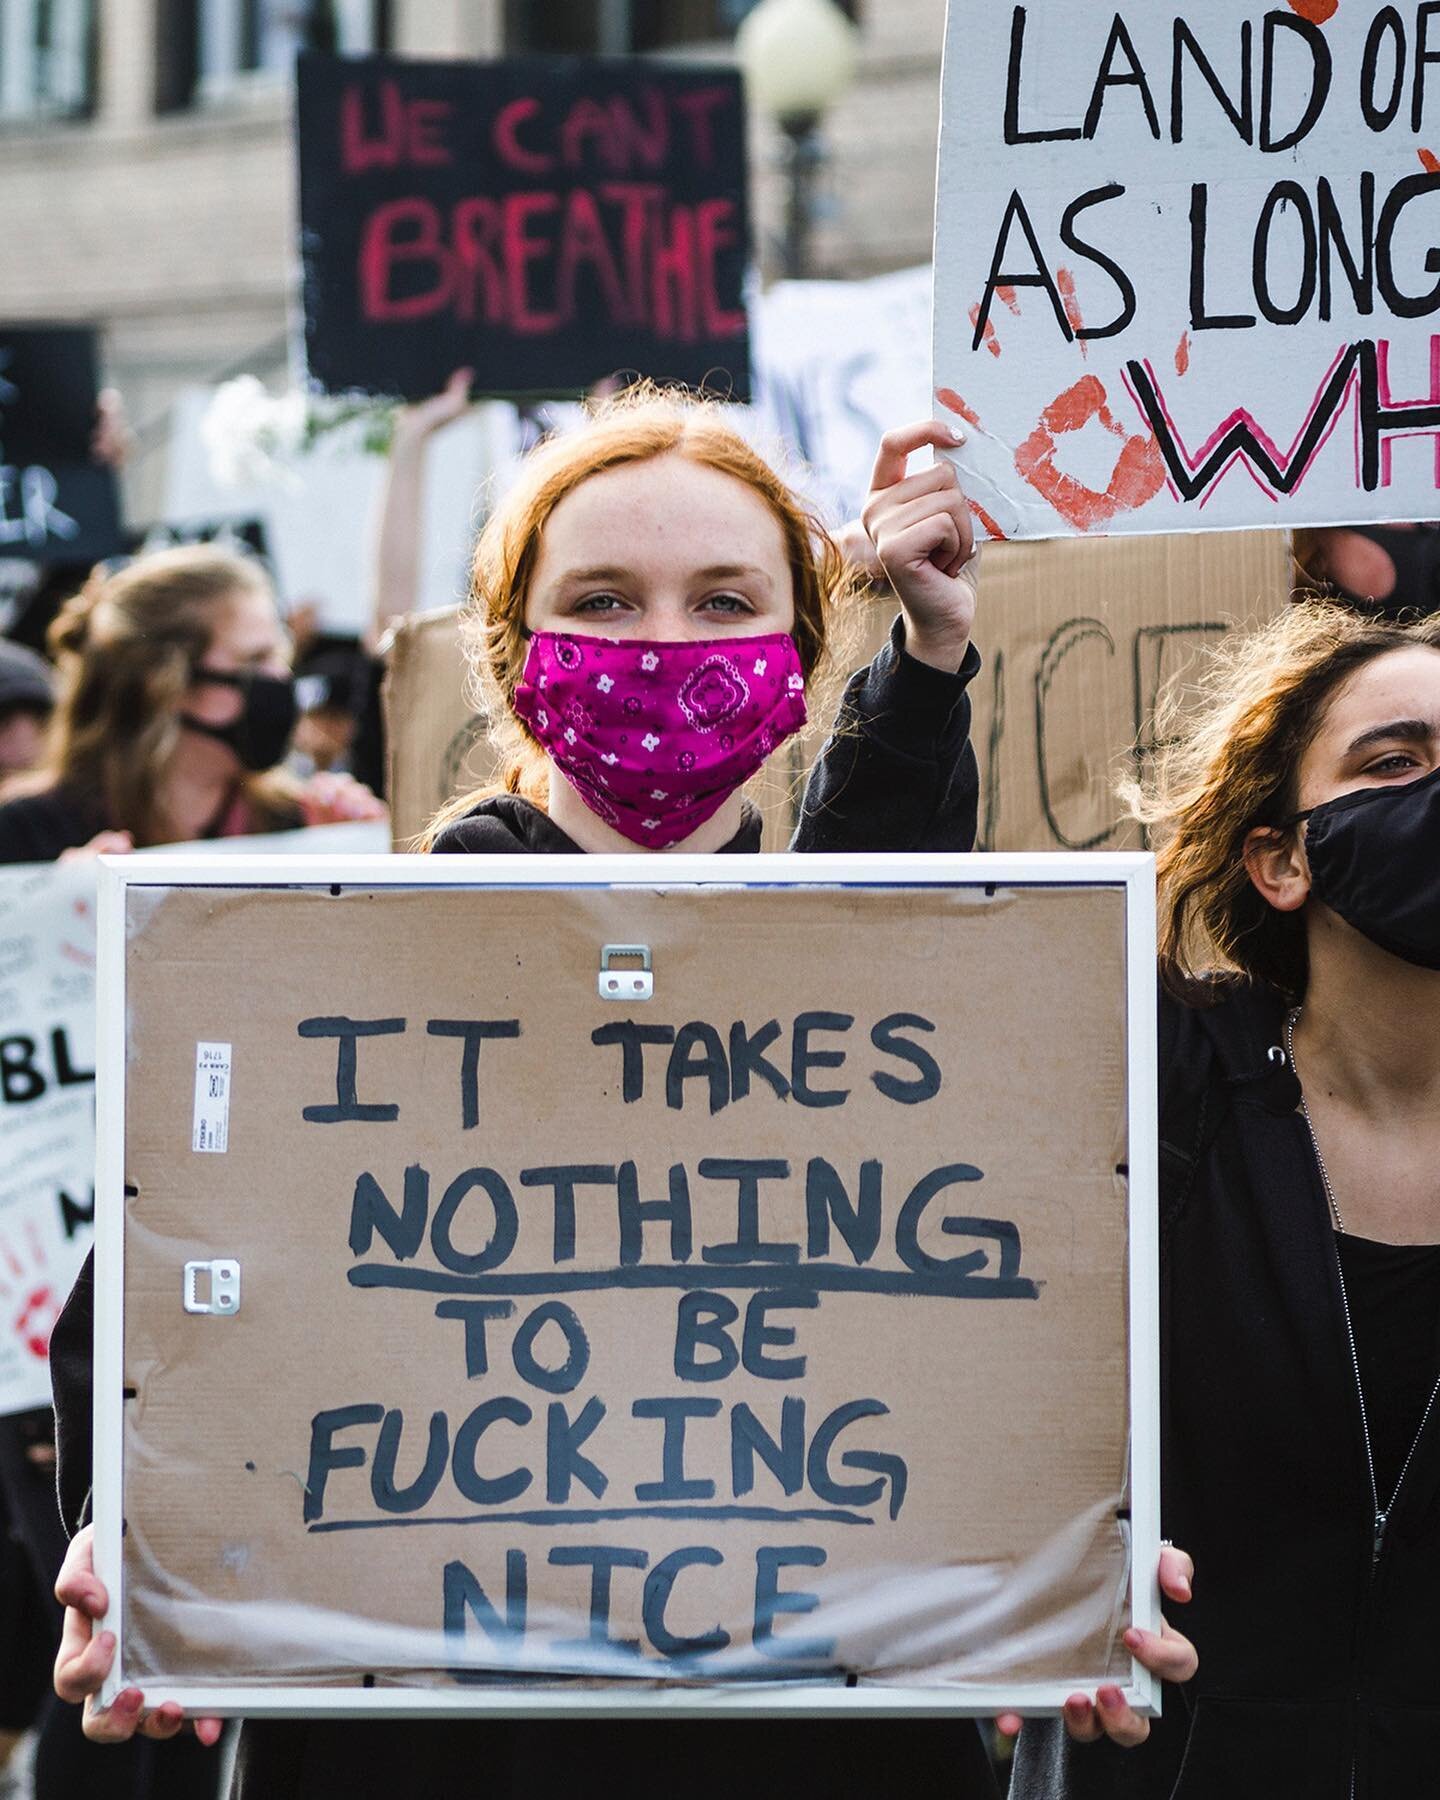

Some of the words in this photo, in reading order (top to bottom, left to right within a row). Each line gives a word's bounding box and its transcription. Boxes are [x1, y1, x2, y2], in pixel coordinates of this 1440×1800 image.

[341, 79, 452, 174] WE
[1004, 5, 1332, 153] LAND
[358, 183, 748, 342] BREATHE
[972, 184, 1137, 351] AS
[1189, 171, 1440, 331] LONG
[297, 1016, 520, 1129] IT
[591, 1011, 942, 1115] TAKES
[348, 1156, 1022, 1277] NOTHING
[434, 1299, 591, 1391] TO
[673, 1289, 821, 1382] BE
[303, 1395, 908, 1523] FUCKING
[443, 1545, 838, 1662] NICE
